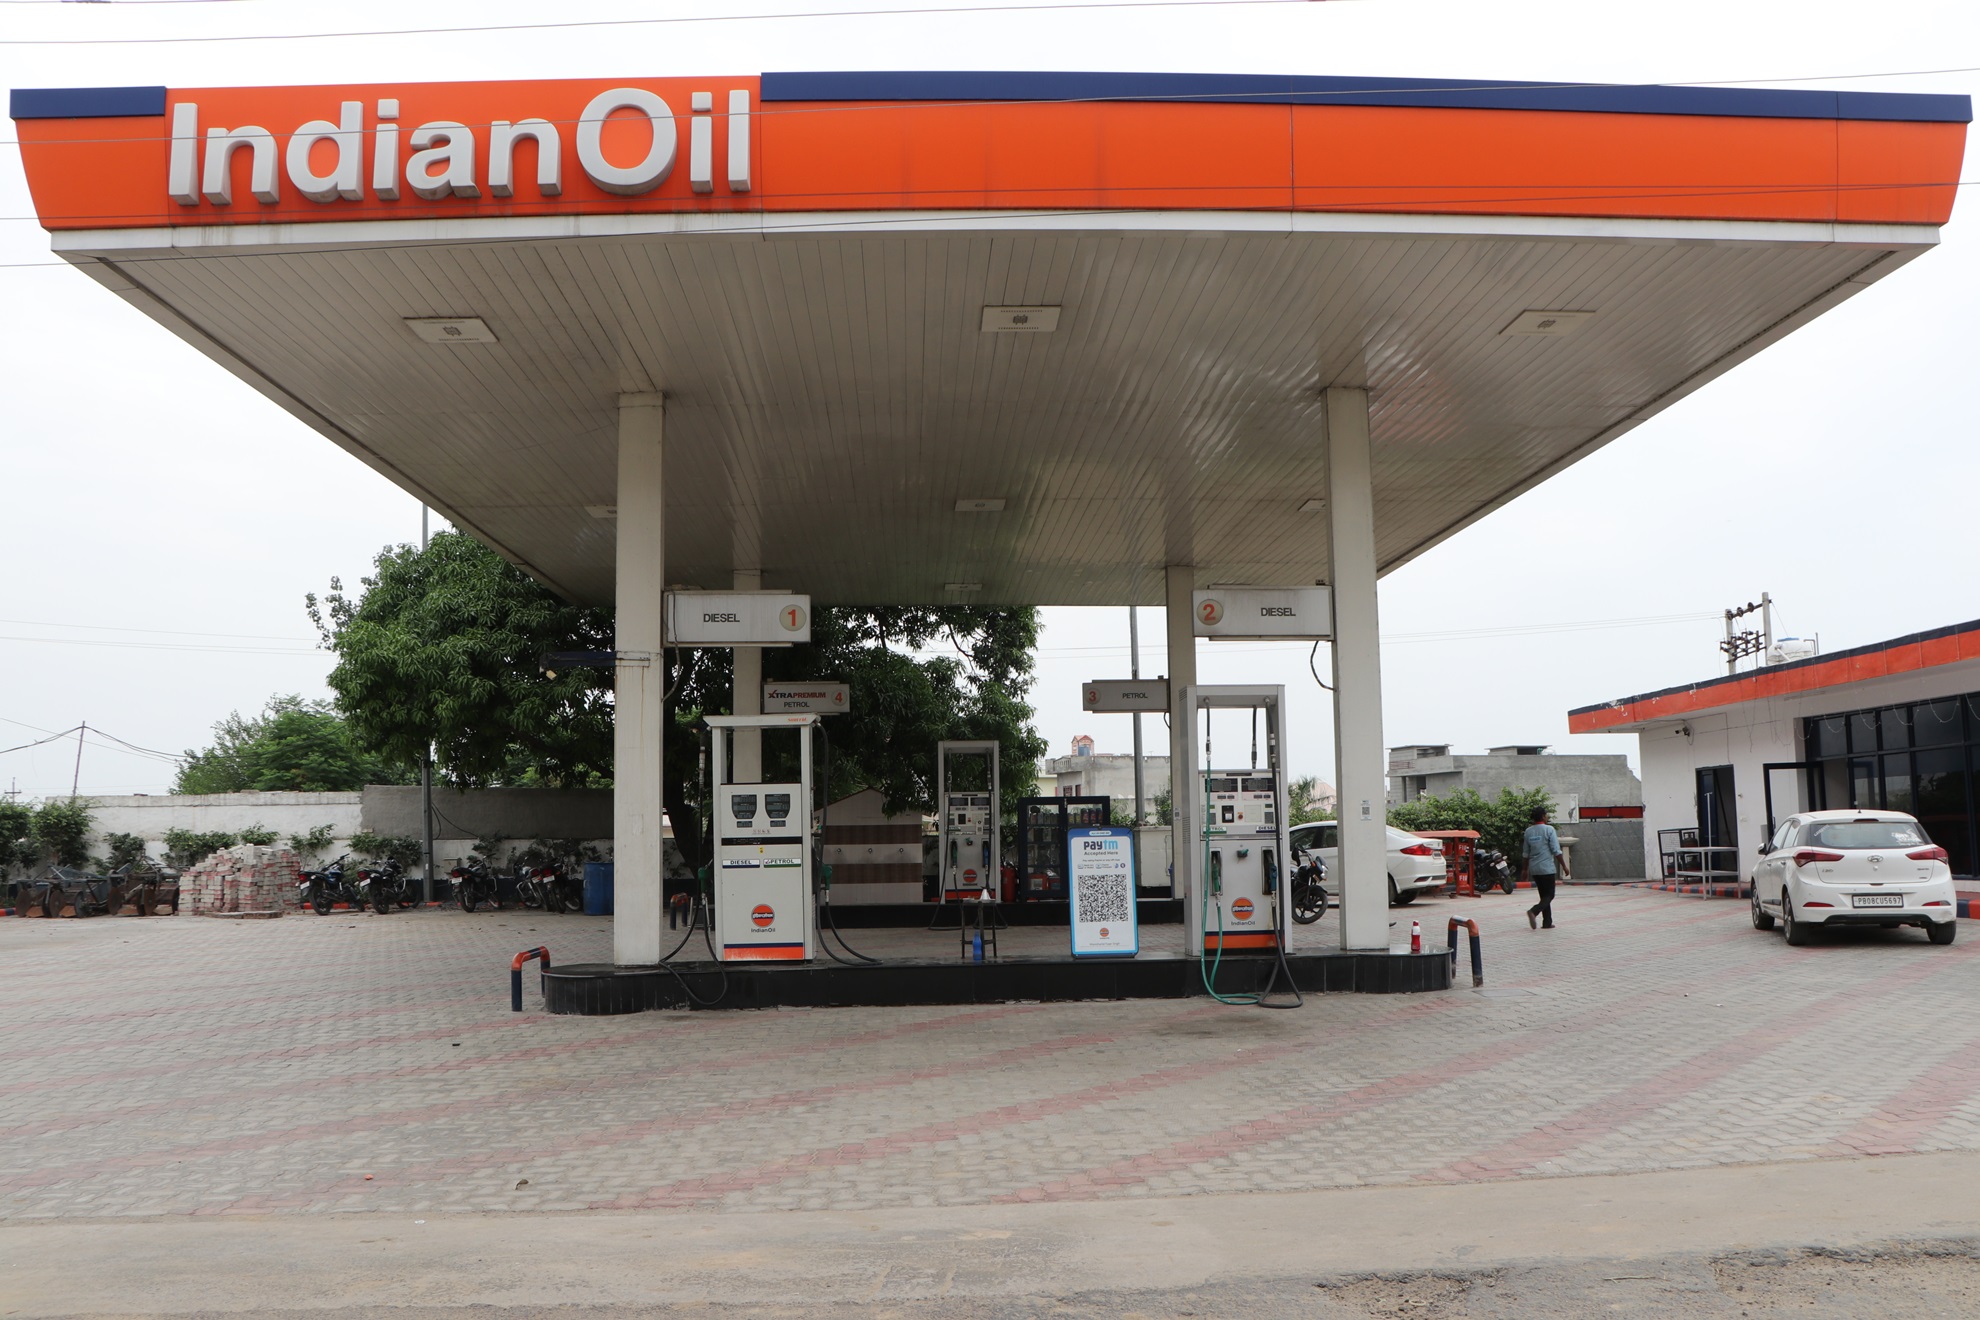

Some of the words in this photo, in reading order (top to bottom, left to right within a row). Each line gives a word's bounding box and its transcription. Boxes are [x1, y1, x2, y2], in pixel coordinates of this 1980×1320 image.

[168, 87, 751, 206] IndianOil
[703, 613, 740, 623] DIESEL
[787, 609, 796, 627] 1
[1202, 603, 1217, 621] 2
[1260, 607, 1296, 617] DIESEL
[834, 692, 843, 703] 4
[1088, 690, 1097, 702] 3
